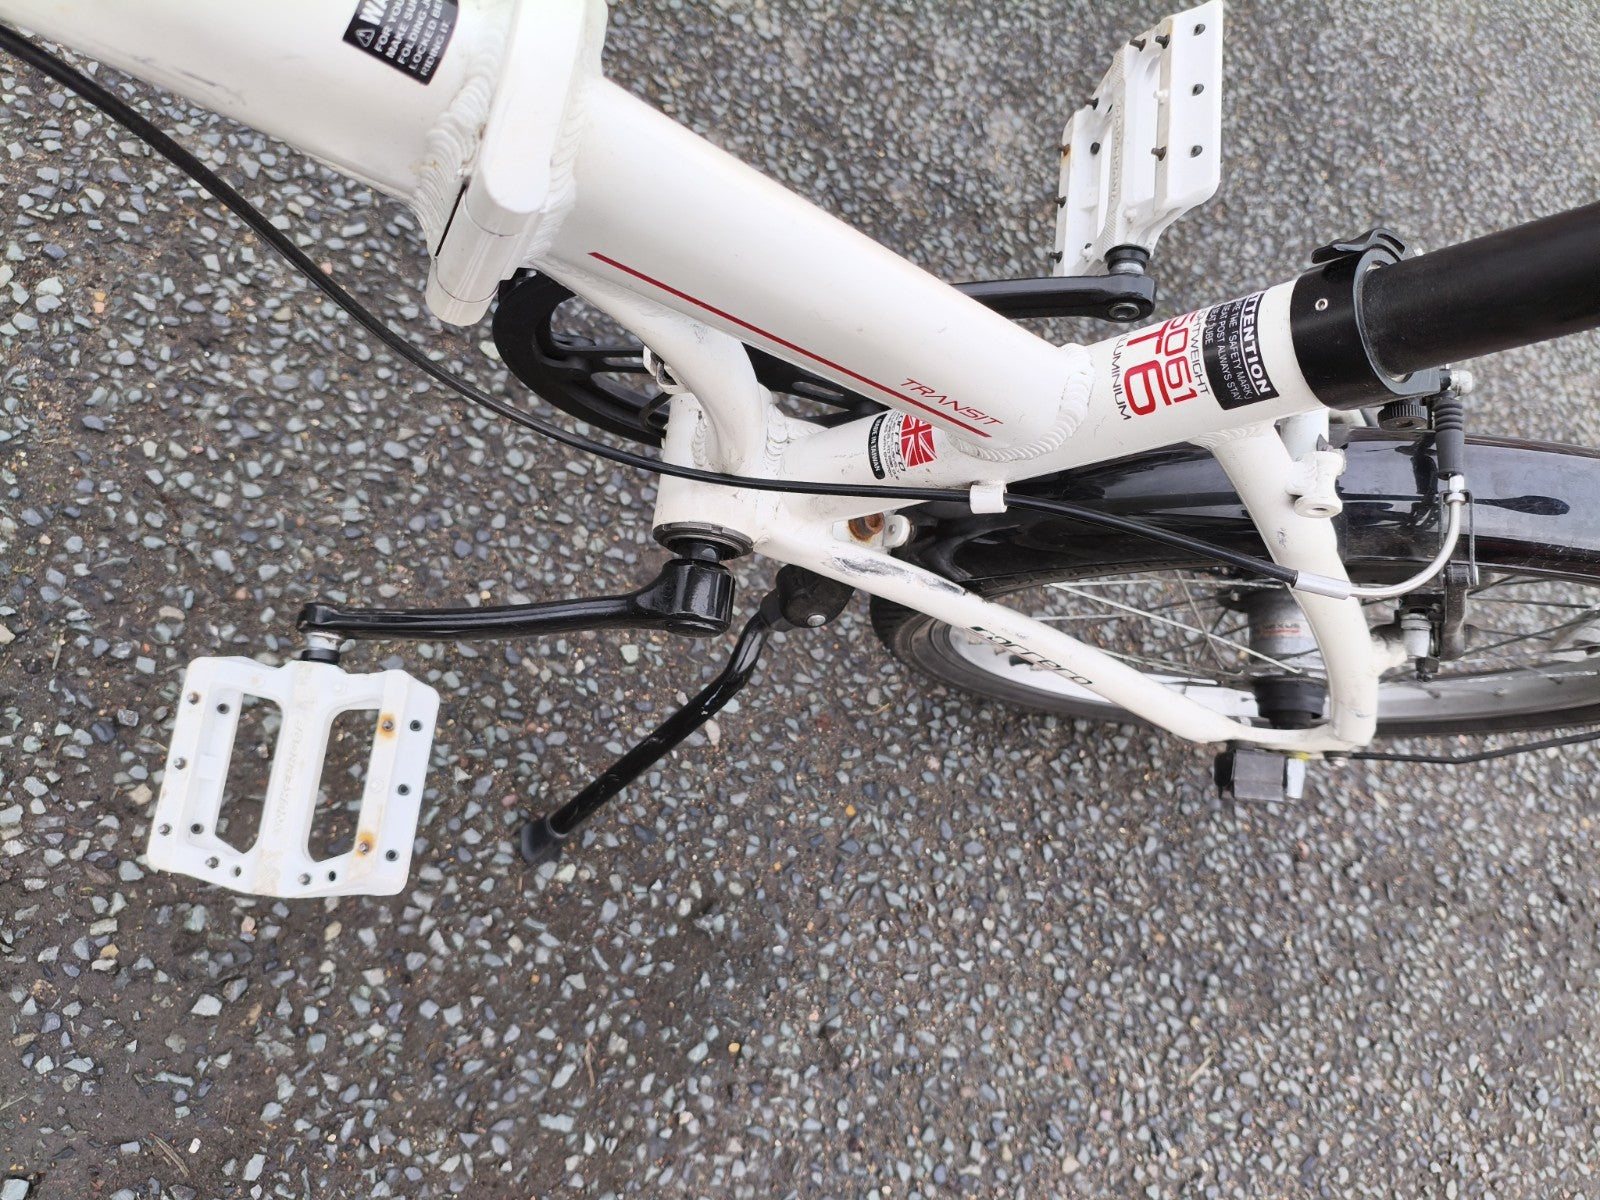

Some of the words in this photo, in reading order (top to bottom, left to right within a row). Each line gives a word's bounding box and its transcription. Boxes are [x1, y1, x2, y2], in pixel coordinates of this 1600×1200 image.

[374, 25, 392, 52] FOR
[386, 23, 408, 58] MAKE
[398, 10, 427, 64] FOLDING
[408, 20, 437, 70] LOCKED
[420, 35, 445, 76] RIDING
[1217, 321, 1226, 342] POST
[1229, 312, 1239, 328] THE
[1124, 321, 1172, 416] T6
[1218, 346, 1232, 381] ALWAYS
[900, 378, 1004, 425] TRANSIT
[1226, 382, 1243, 400] STAY
[871, 444, 881, 472] TAIWAN
